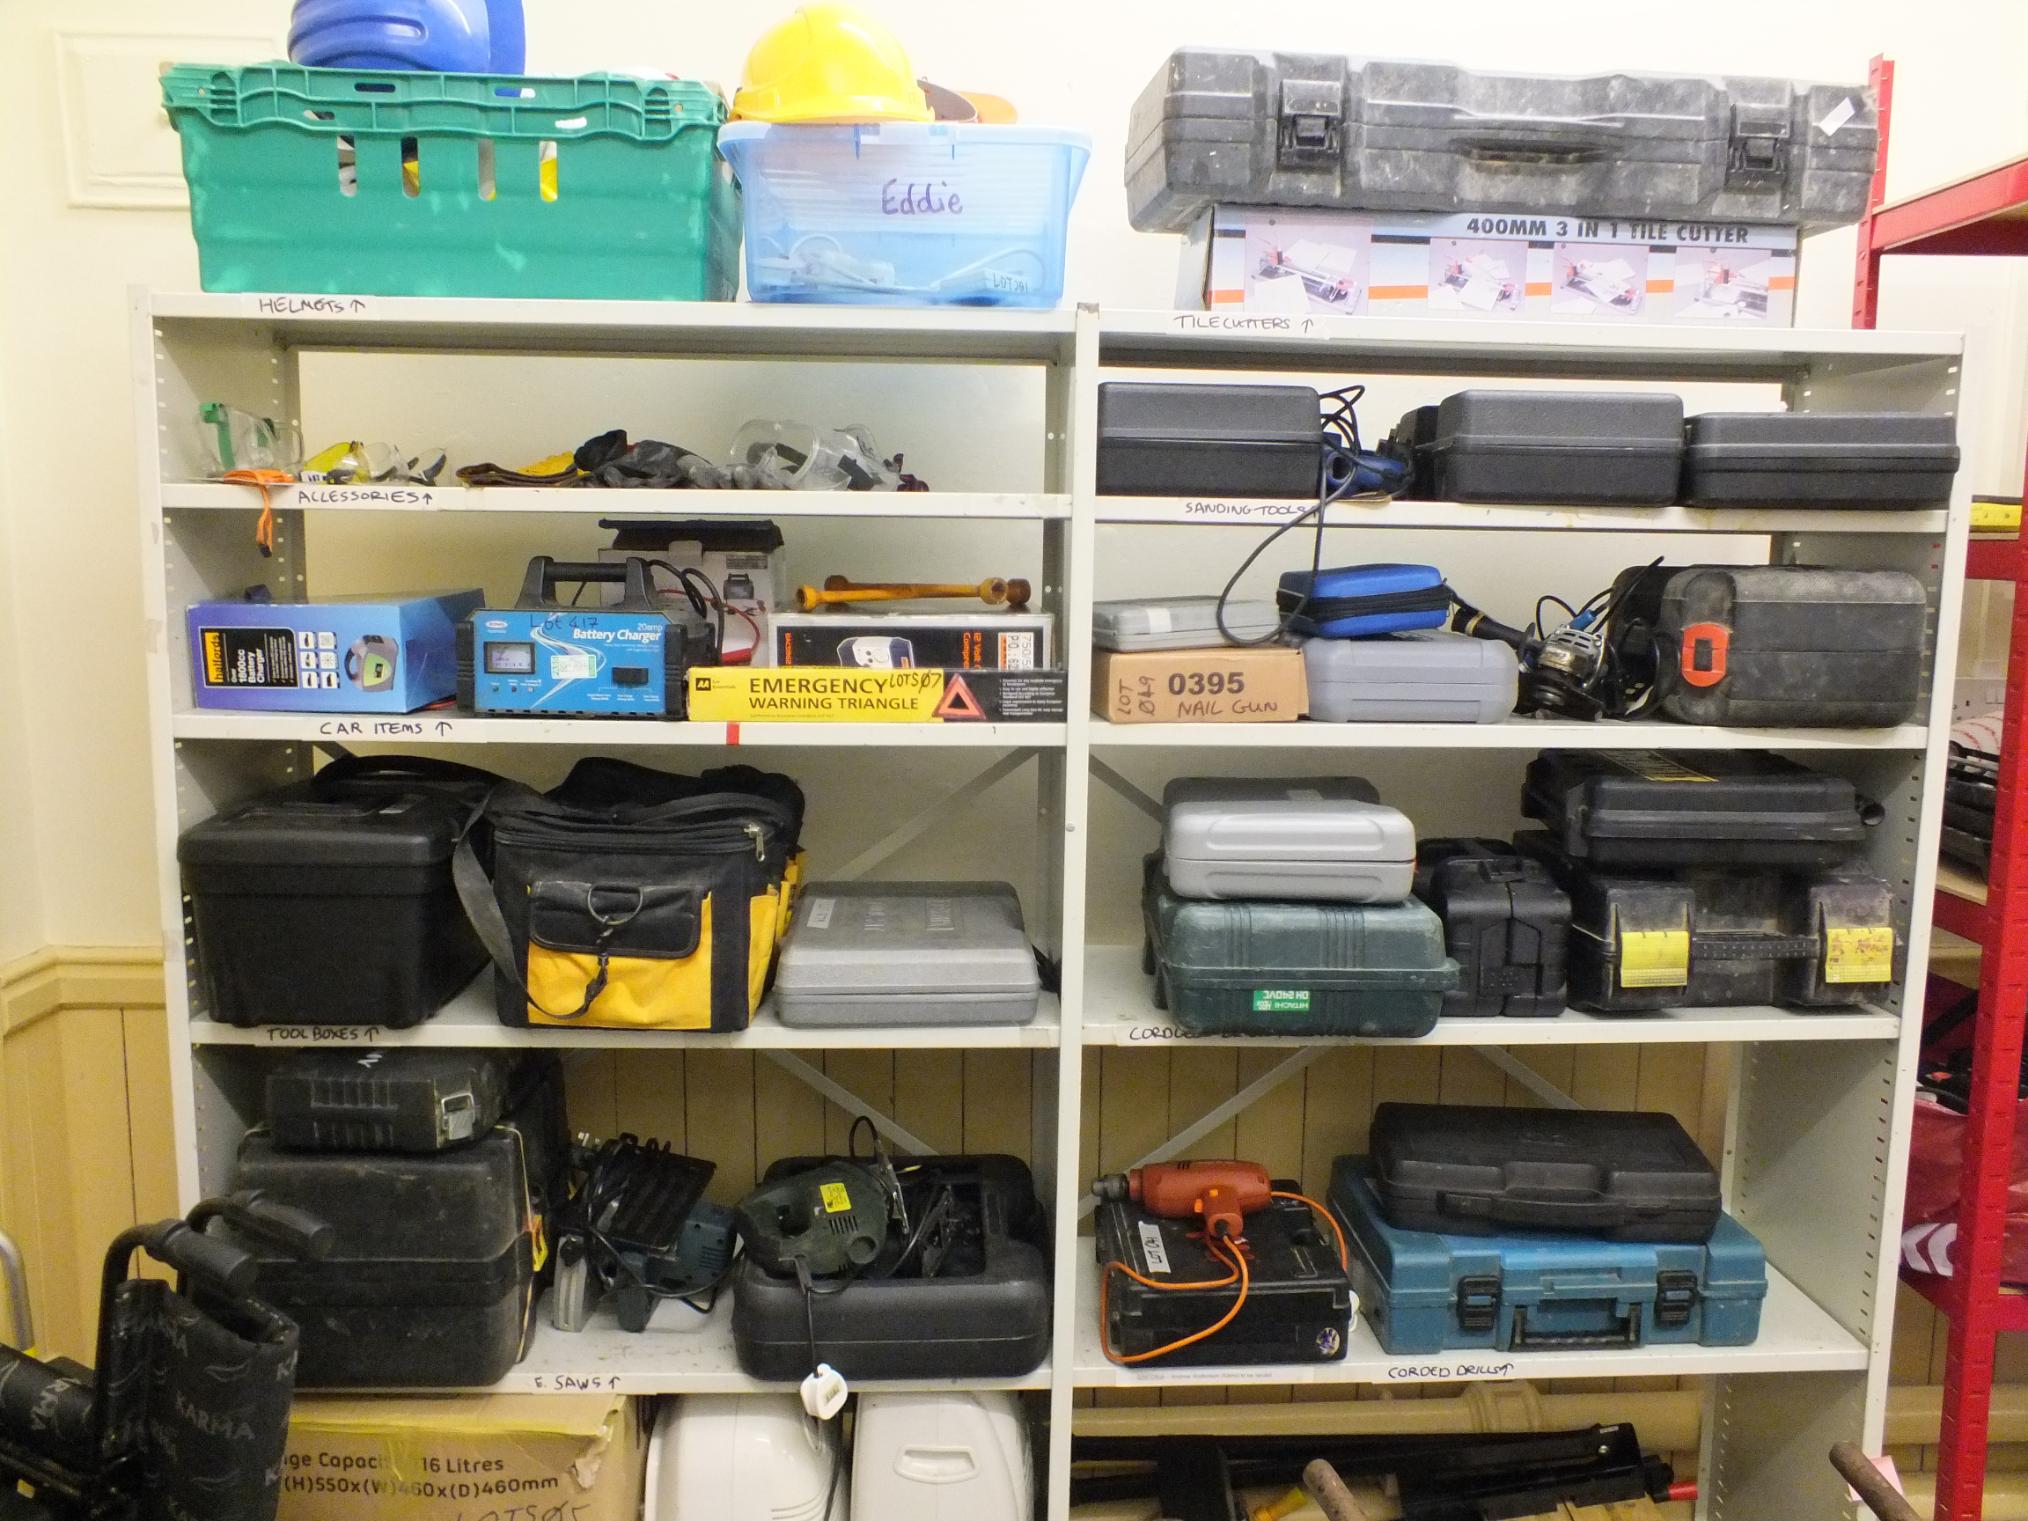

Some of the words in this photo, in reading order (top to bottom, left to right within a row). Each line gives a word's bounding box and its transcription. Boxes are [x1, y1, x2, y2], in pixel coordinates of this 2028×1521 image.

[881, 178, 963, 215] Eddie
[1467, 218, 1547, 236] 400MM
[1556, 221, 1568, 237] 3
[1577, 221, 1599, 238] IN
[1610, 221, 1618, 238] 1
[1630, 222, 1667, 240] TILE
[1676, 224, 1749, 243] CUTTER
[1185, 502, 1251, 515] SANDING
[568, 616, 599, 629] 417
[573, 628, 614, 643] Battery
[617, 628, 662, 644] Charger
[211, 633, 224, 681] halfords
[256, 648, 266, 684] Charger
[749, 678, 888, 694] EMERGENCY
[1168, 672, 1245, 695] 0395
[749, 697, 832, 710] WARNING
[838, 697, 919, 710] TRIANGLE
[1118, 678, 1134, 715] LOT
[1177, 701, 1223, 718] NAIL
[1231, 699, 1278, 714] GUN
[320, 722, 362, 735] CAR
[374, 722, 422, 735] ITEMS
[267, 1027, 308, 1040] TOOL
[313, 1026, 358, 1040] BOXES
[1388, 1367, 1450, 1379] CORDED
[554, 1375, 601, 1391] SAWS
[446, 1458, 504, 1473] Litres
